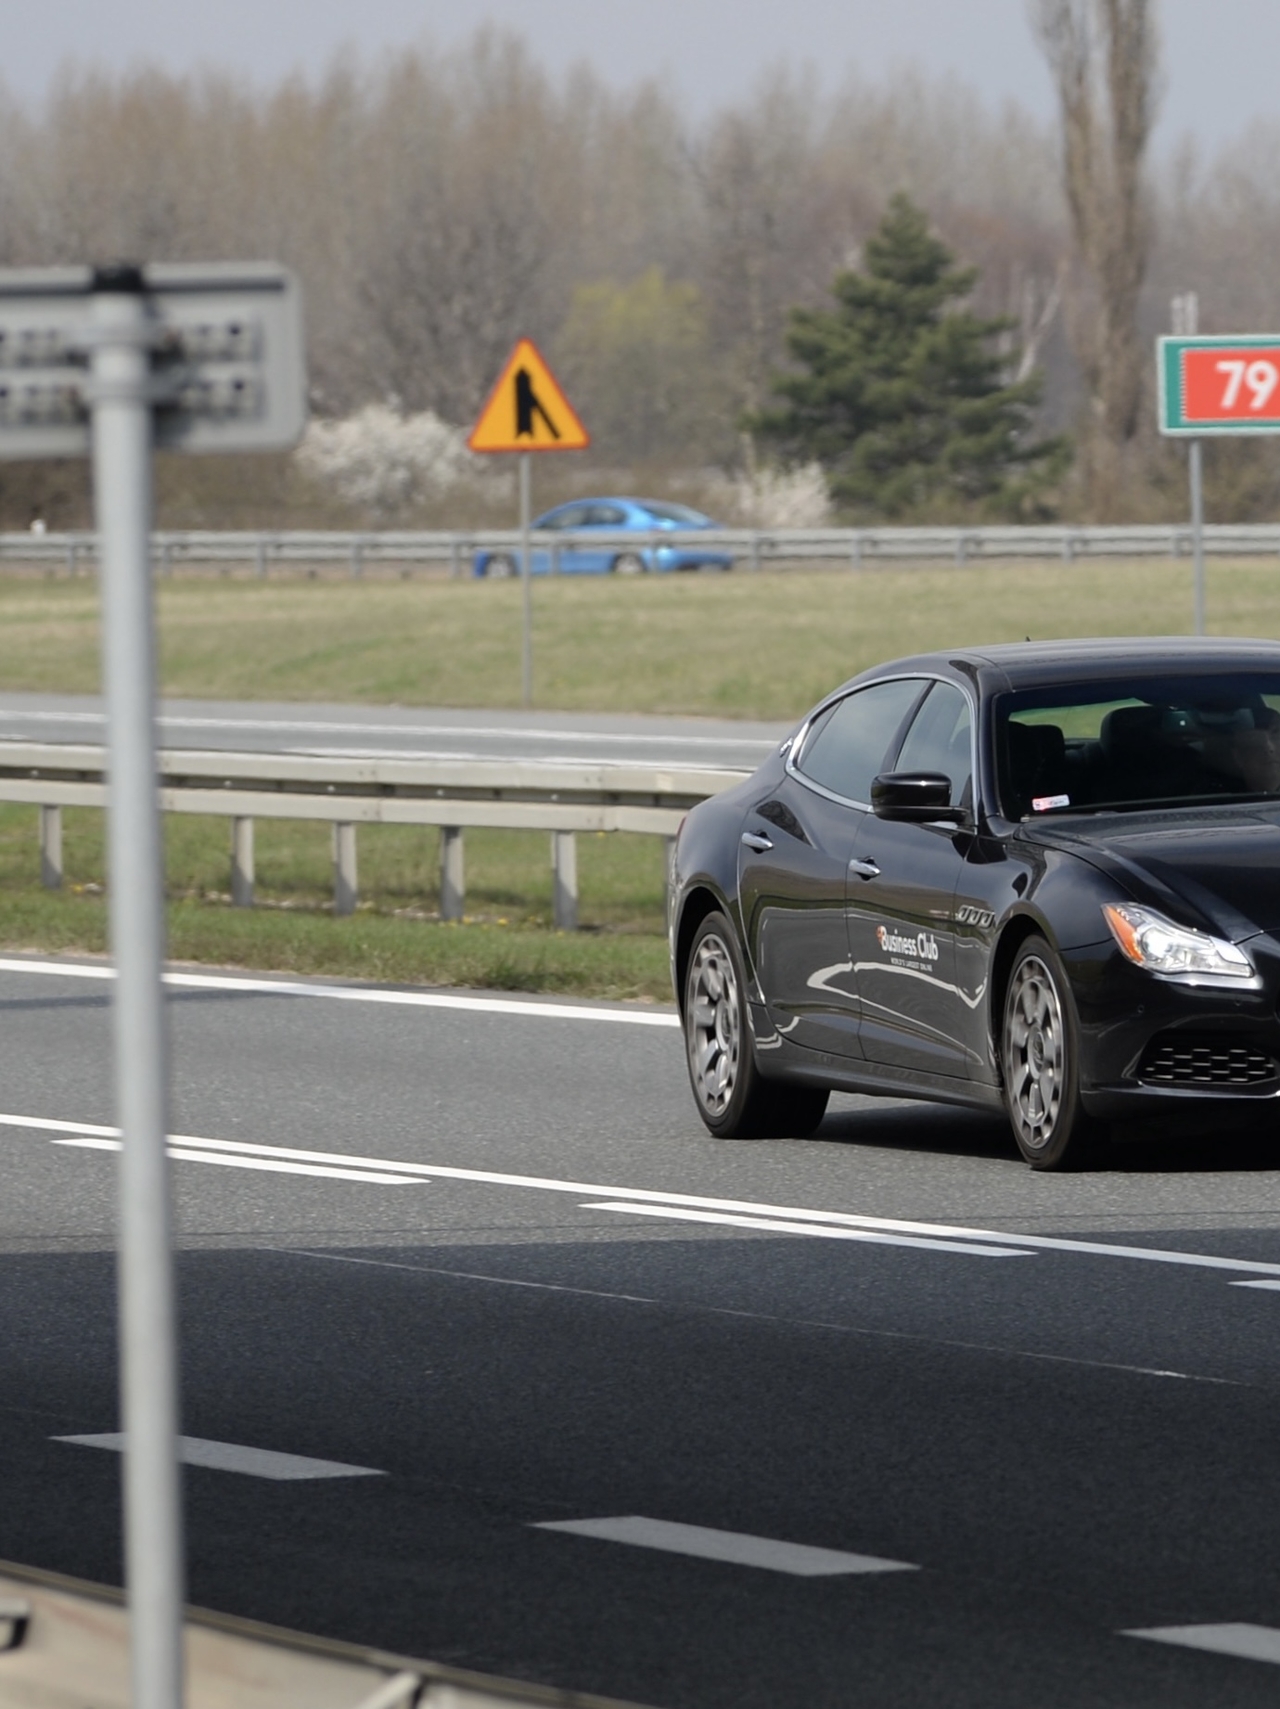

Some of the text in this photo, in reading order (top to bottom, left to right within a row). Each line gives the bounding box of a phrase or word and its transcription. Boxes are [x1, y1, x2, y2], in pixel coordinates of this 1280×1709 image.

[1216, 361, 1278, 410] 79
[876, 926, 938, 960] Business Club
